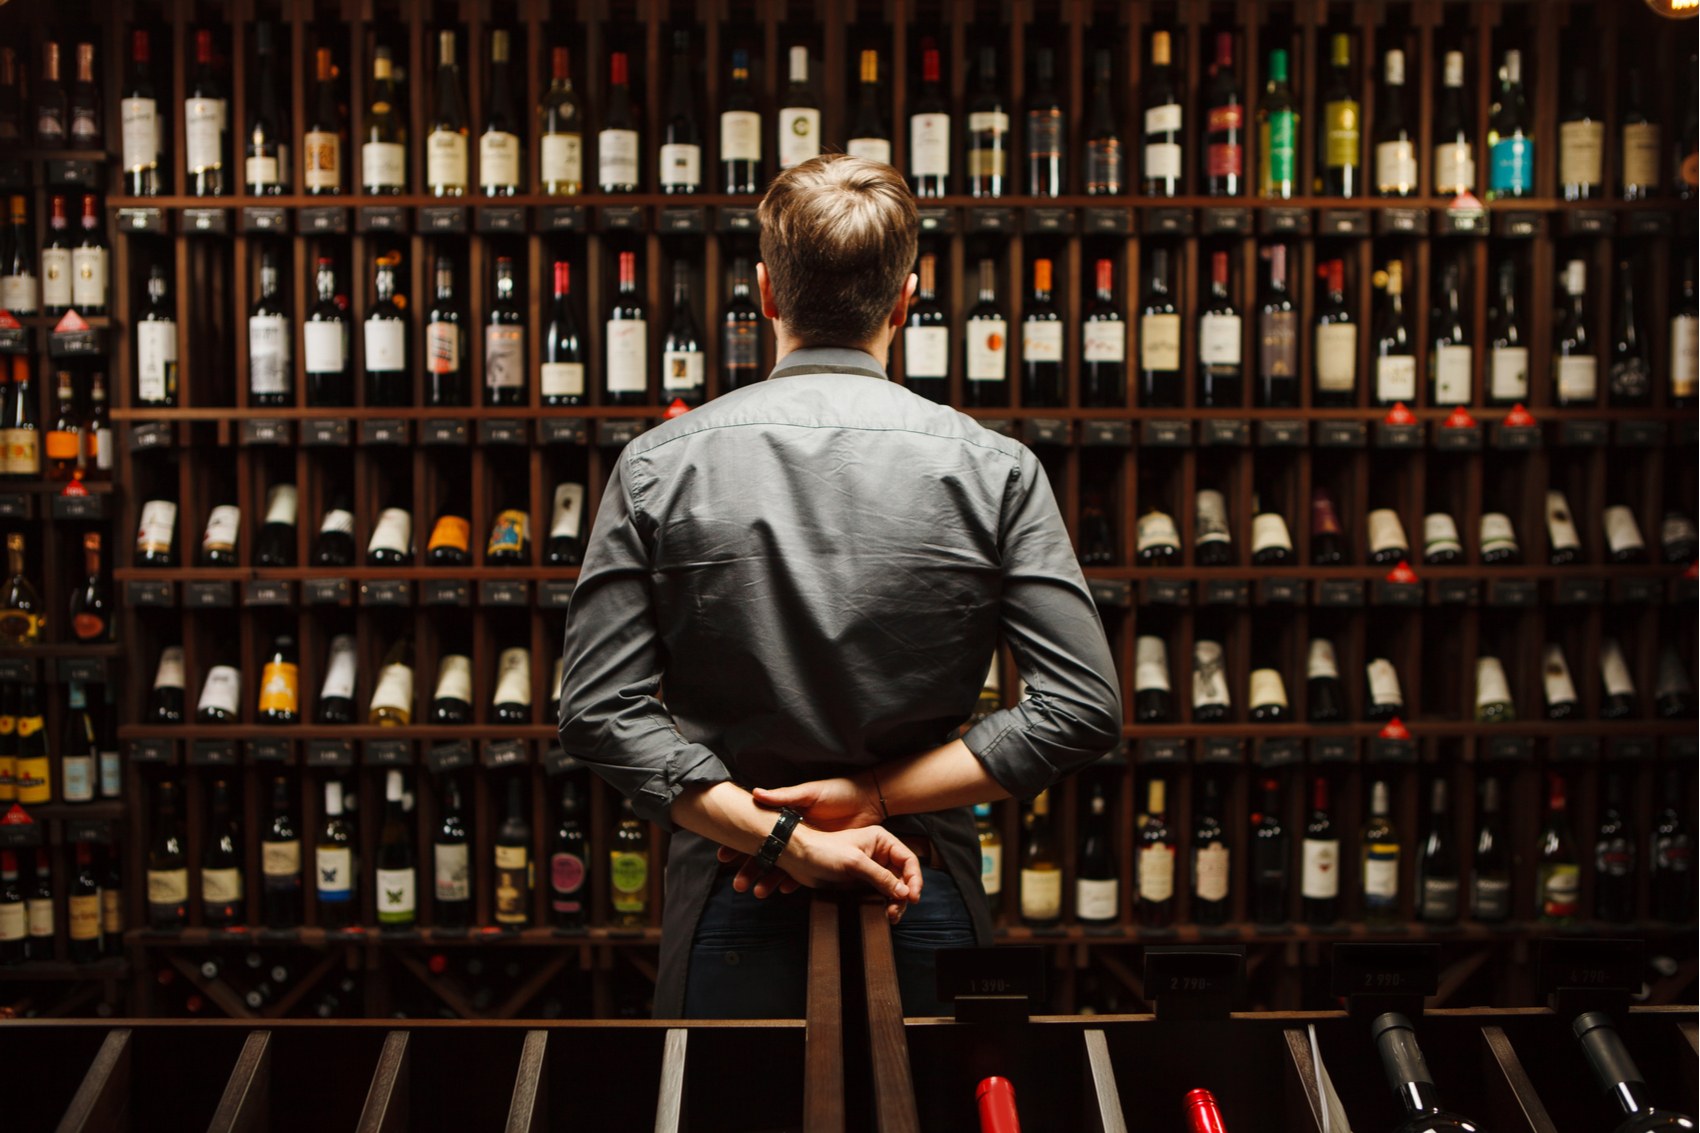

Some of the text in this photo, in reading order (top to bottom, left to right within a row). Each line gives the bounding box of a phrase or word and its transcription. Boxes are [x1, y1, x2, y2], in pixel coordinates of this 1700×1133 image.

[1364, 973, 1406, 986] 2 990-
[1570, 969, 1610, 983] 4 790-
[970, 978, 1011, 992] 1 390-
[1170, 977, 1212, 990] 2 790-
